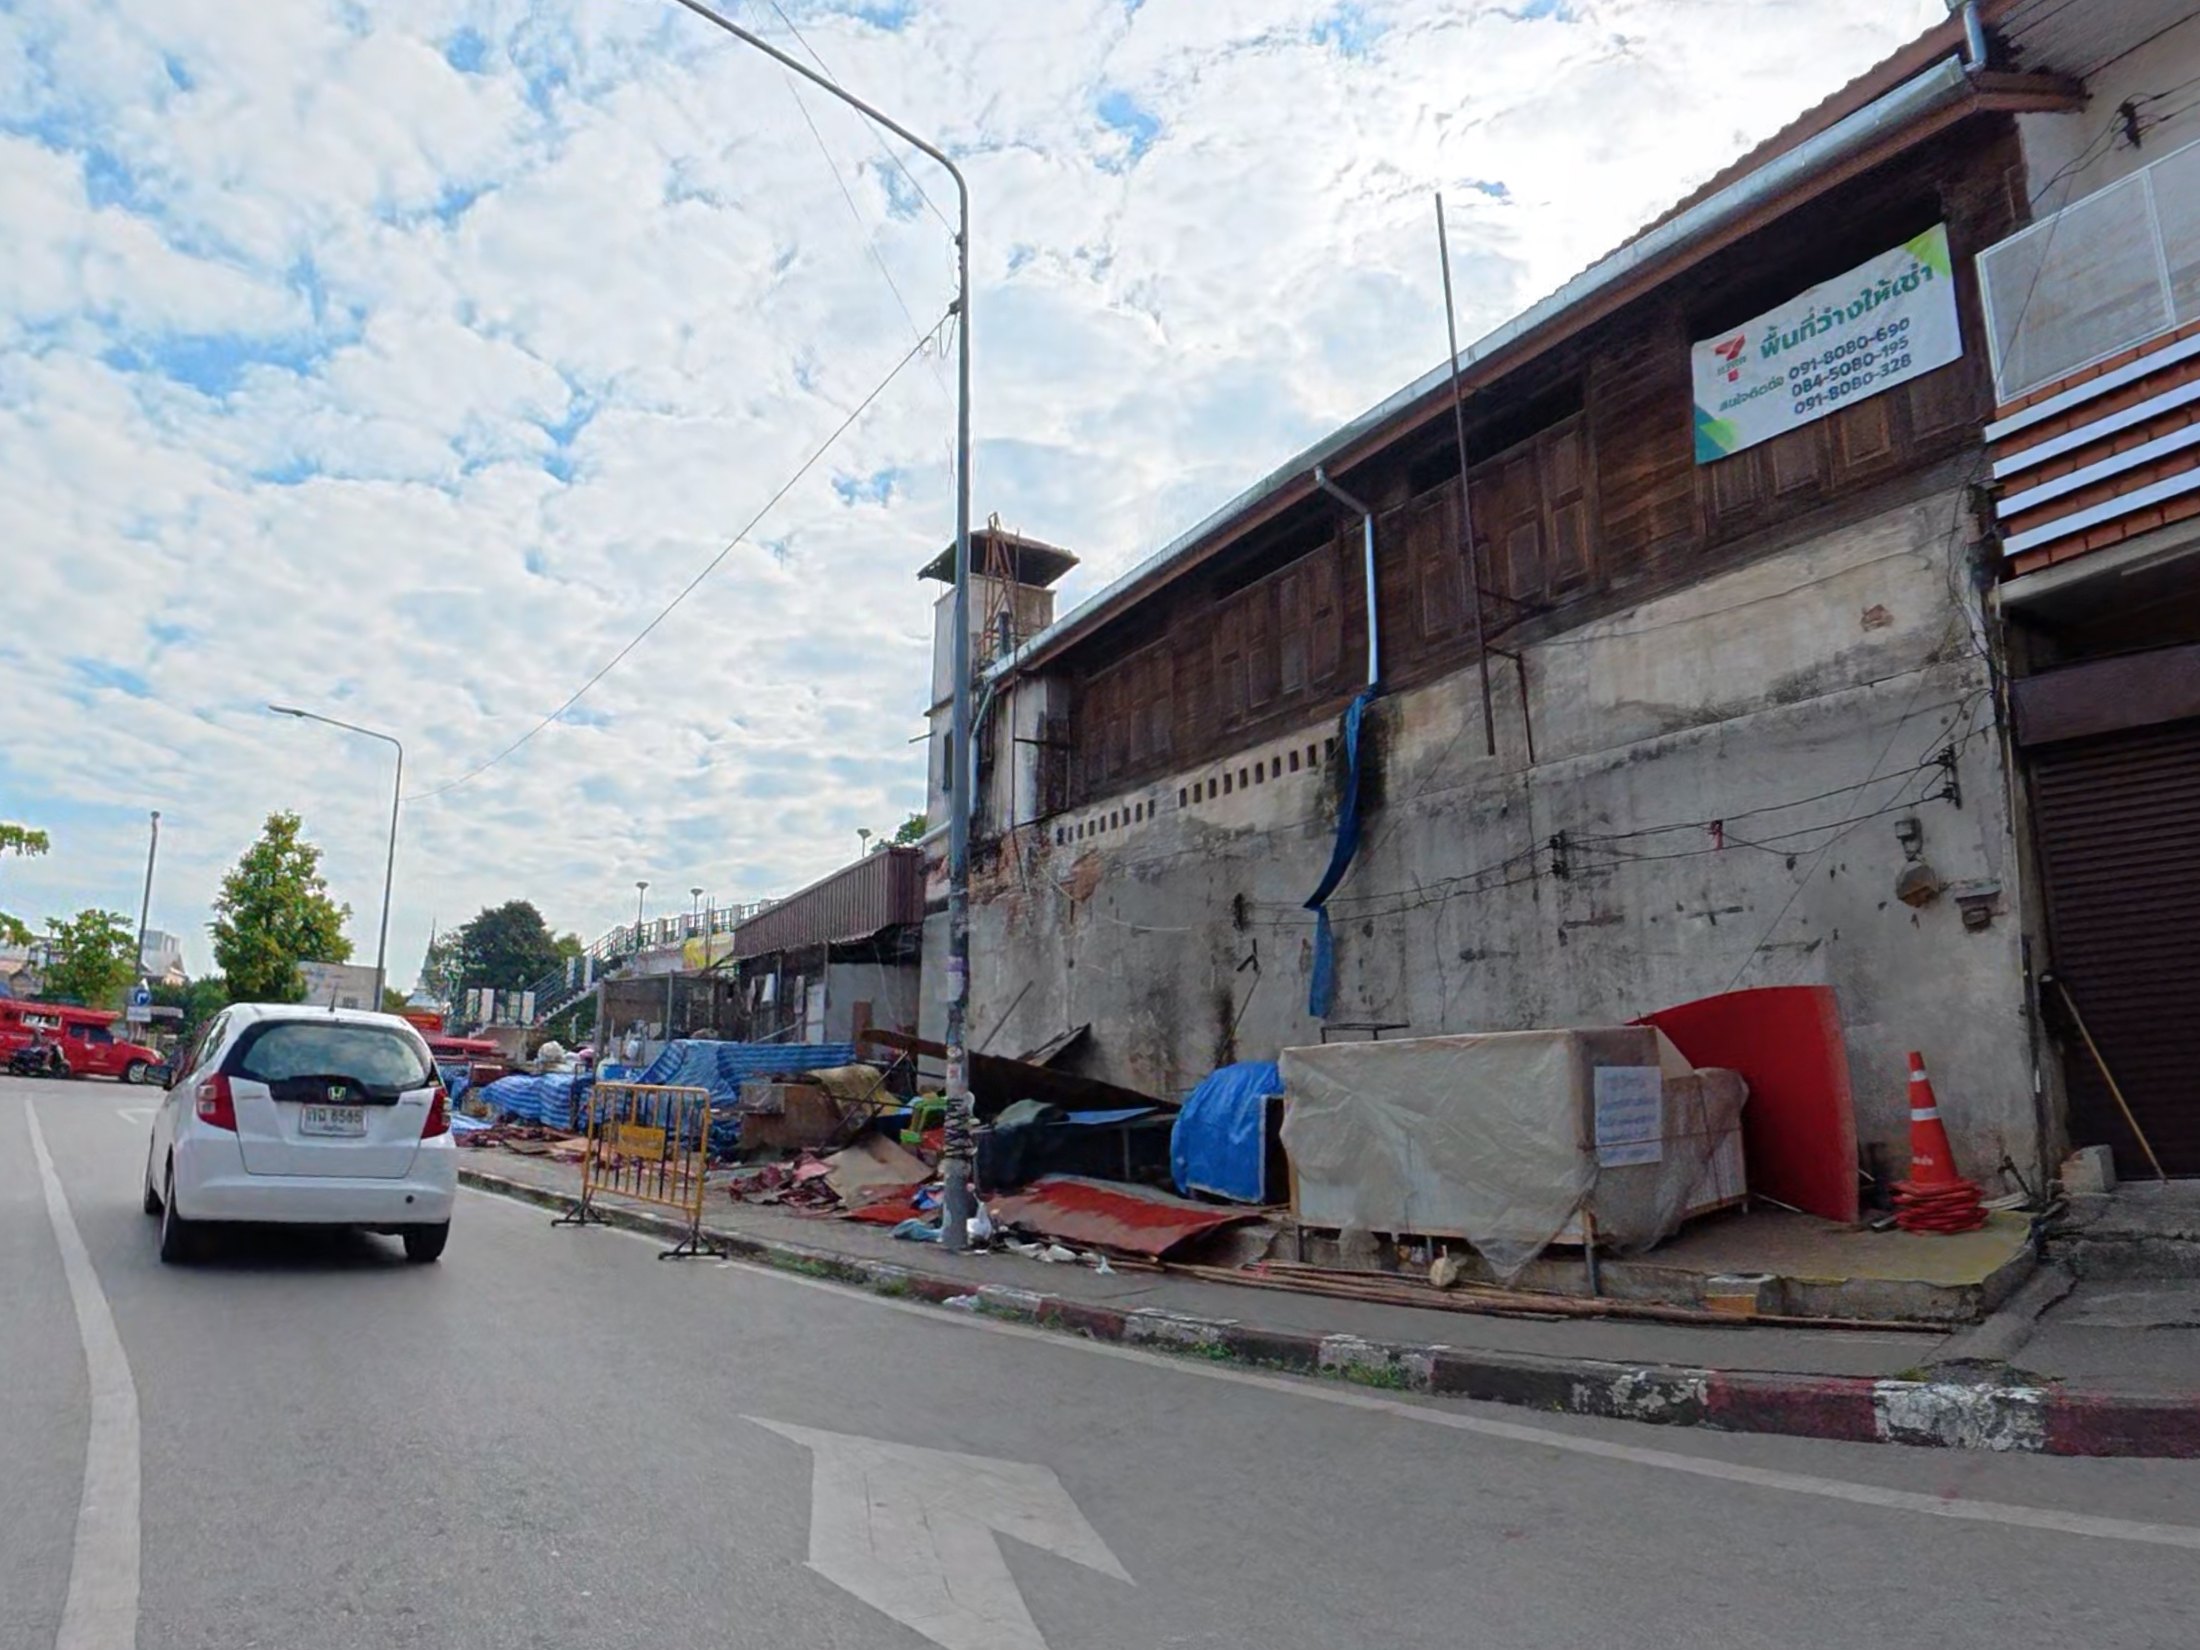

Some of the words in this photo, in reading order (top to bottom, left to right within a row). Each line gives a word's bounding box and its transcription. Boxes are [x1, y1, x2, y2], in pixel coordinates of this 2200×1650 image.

[1760, 262, 1934, 359] พื้นที่ว่างให้เช่า
[1788, 317, 1911, 380] 091-8080-690
[1792, 335, 1910, 398] 084-5080-195
[1794, 353, 1912, 415] 091-8080-328
